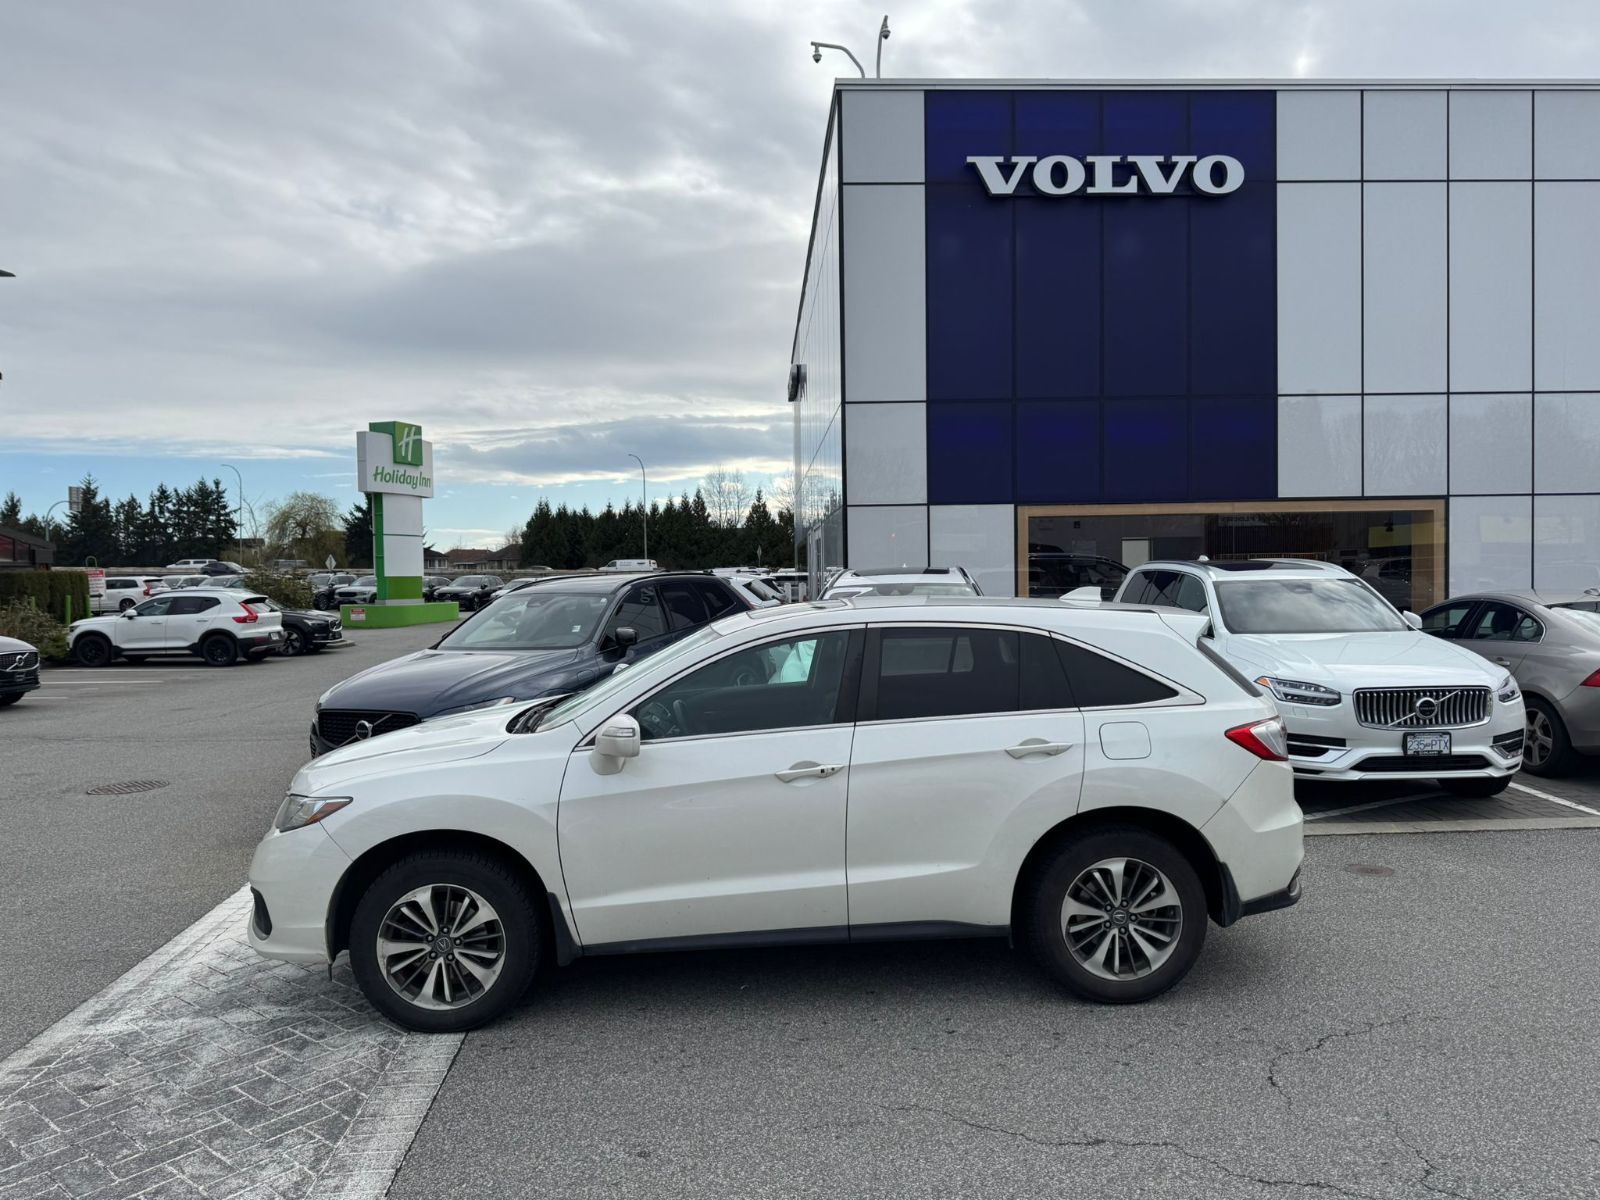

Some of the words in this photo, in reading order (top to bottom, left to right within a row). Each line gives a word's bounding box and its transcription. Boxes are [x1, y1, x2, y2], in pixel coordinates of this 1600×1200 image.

[966, 154, 1245, 196] VOLVO
[373, 466, 418, 489] Holiday
[419, 471, 431, 488] Inn
